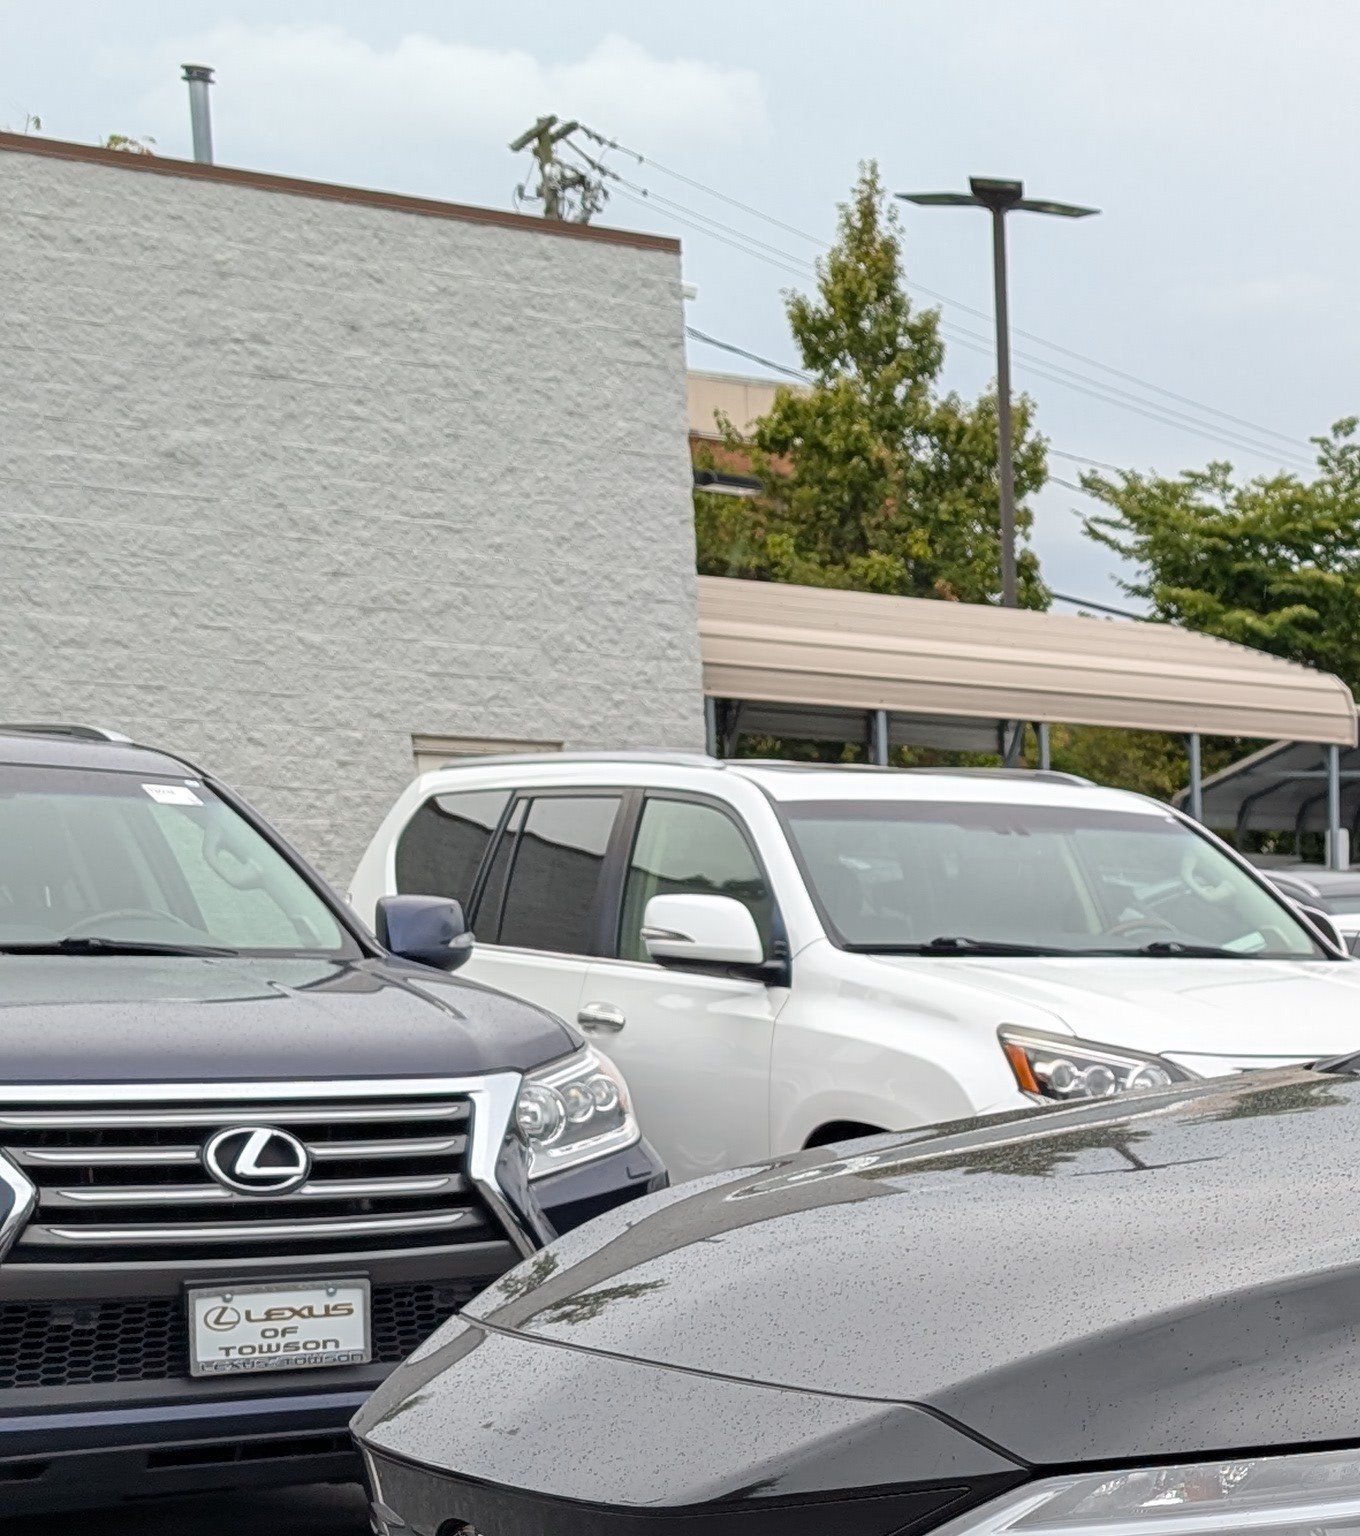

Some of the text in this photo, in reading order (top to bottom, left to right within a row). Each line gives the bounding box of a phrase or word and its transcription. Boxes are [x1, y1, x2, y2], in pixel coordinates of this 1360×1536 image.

[244, 1302, 355, 1324] LEXUS
[260, 1326, 299, 1339] OF
[218, 1338, 341, 1357] TOWSON
